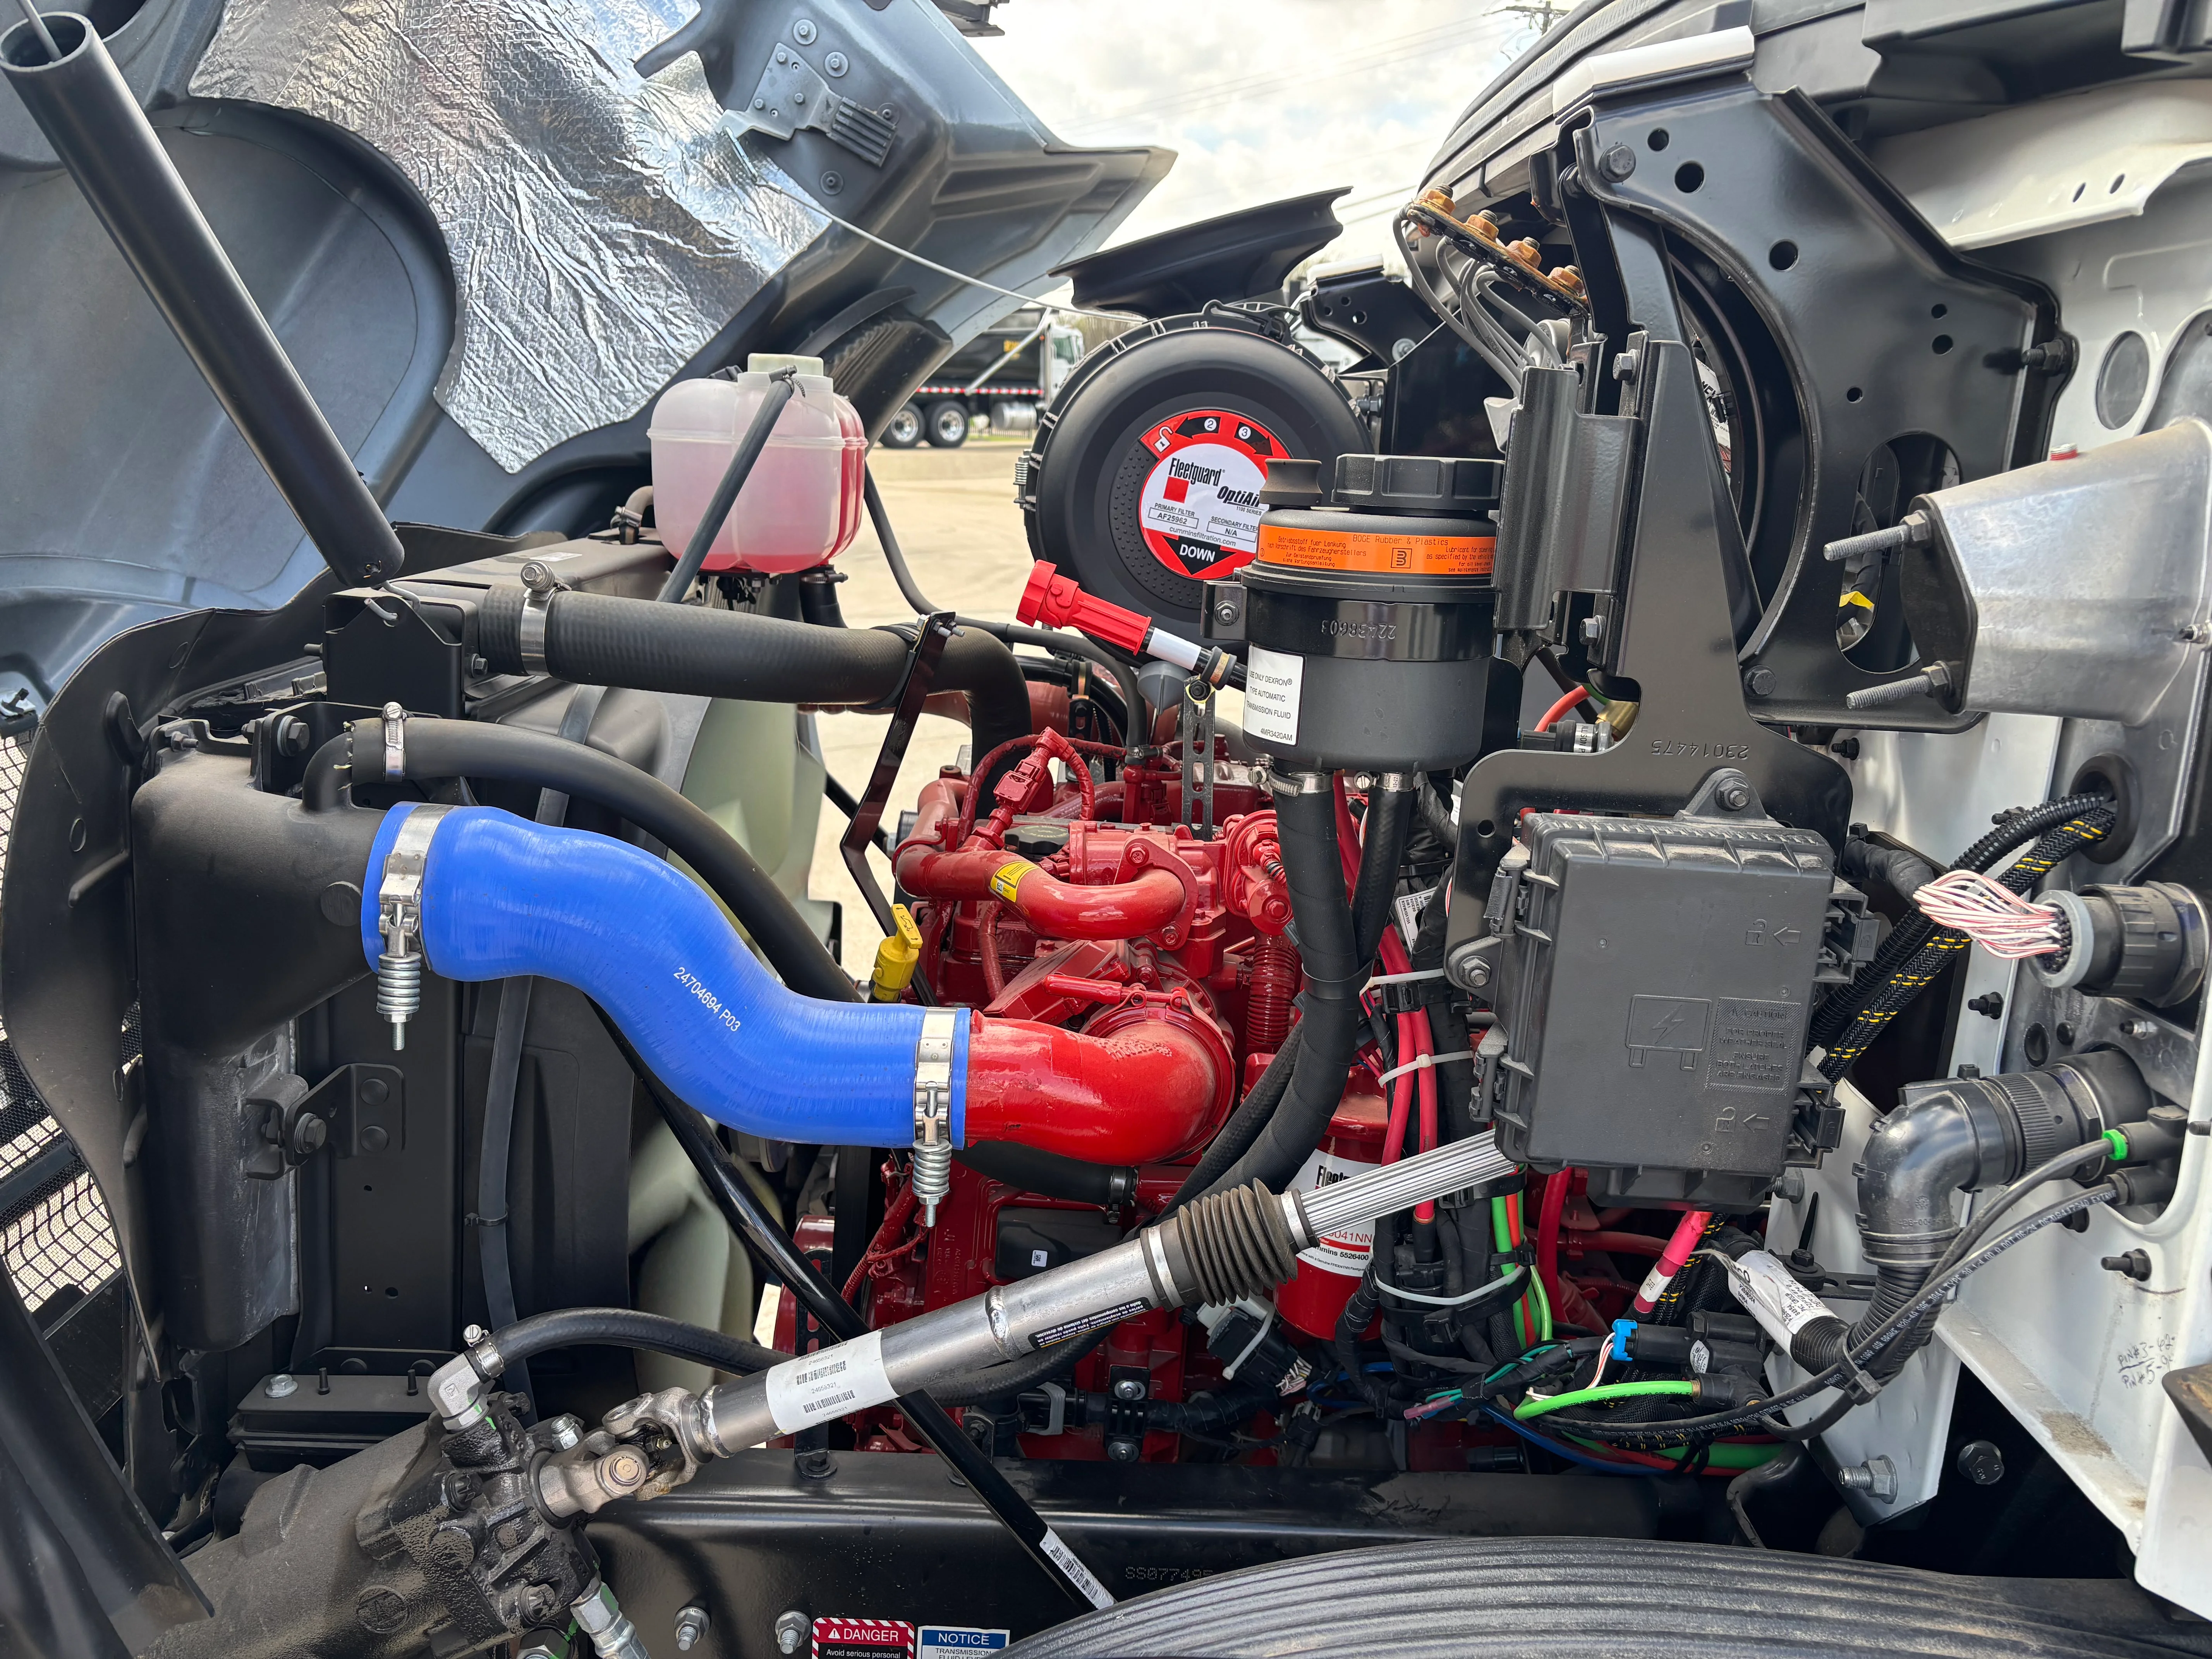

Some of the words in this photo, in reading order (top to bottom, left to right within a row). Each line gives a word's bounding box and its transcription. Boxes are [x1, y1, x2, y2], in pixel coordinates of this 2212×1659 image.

[1169, 457, 1222, 487] Fleetguard
[1217, 486, 1260, 508] OptiAi
[1154, 503, 1177, 513] PRIMARY
[1178, 508, 1195, 517] FILTER
[1246, 508, 1262, 516] SERIES
[1157, 512, 1187, 525] AF25962
[1211, 516, 1242, 528] SECONDARY
[1169, 526, 1236, 547] cumminsfiltration.com
[1225, 528, 1237, 537] N/A
[1376, 536, 1402, 544] Rubber
[1416, 538, 1449, 546] Plastics
[1180, 544, 1216, 562] DOWN
[1255, 672, 1265, 681] ONLY
[1258, 689, 1286, 702] AUTOMATIC
[1247, 700, 1273, 716] TRANSMISSION
[1274, 710, 1291, 719] FLUID
[1651, 740, 1749, 760] 23014475
[673, 967, 722, 1014] 24704694
[718, 1008, 741, 1032] P03
[1744, 1009, 1786, 1020] CAUTION
[1726, 1027, 1744, 1036] FOR
[1747, 1029, 1784, 1039] PROPER
[1733, 1051, 1770, 1061] ENSURE
[1716, 1060, 1740, 1069] BOTH
[1743, 1062, 1783, 1072] LATCHES
[1340, 1251, 1369, 1261] 5526400
[844, 1630, 899, 1642] DANGER
[938, 1632, 990, 1645] NOTICE
[826, 1649, 845, 1657] Avoid
[872, 1651, 901, 1659] personal
[935, 1647, 991, 1656] TRANSMISSION
